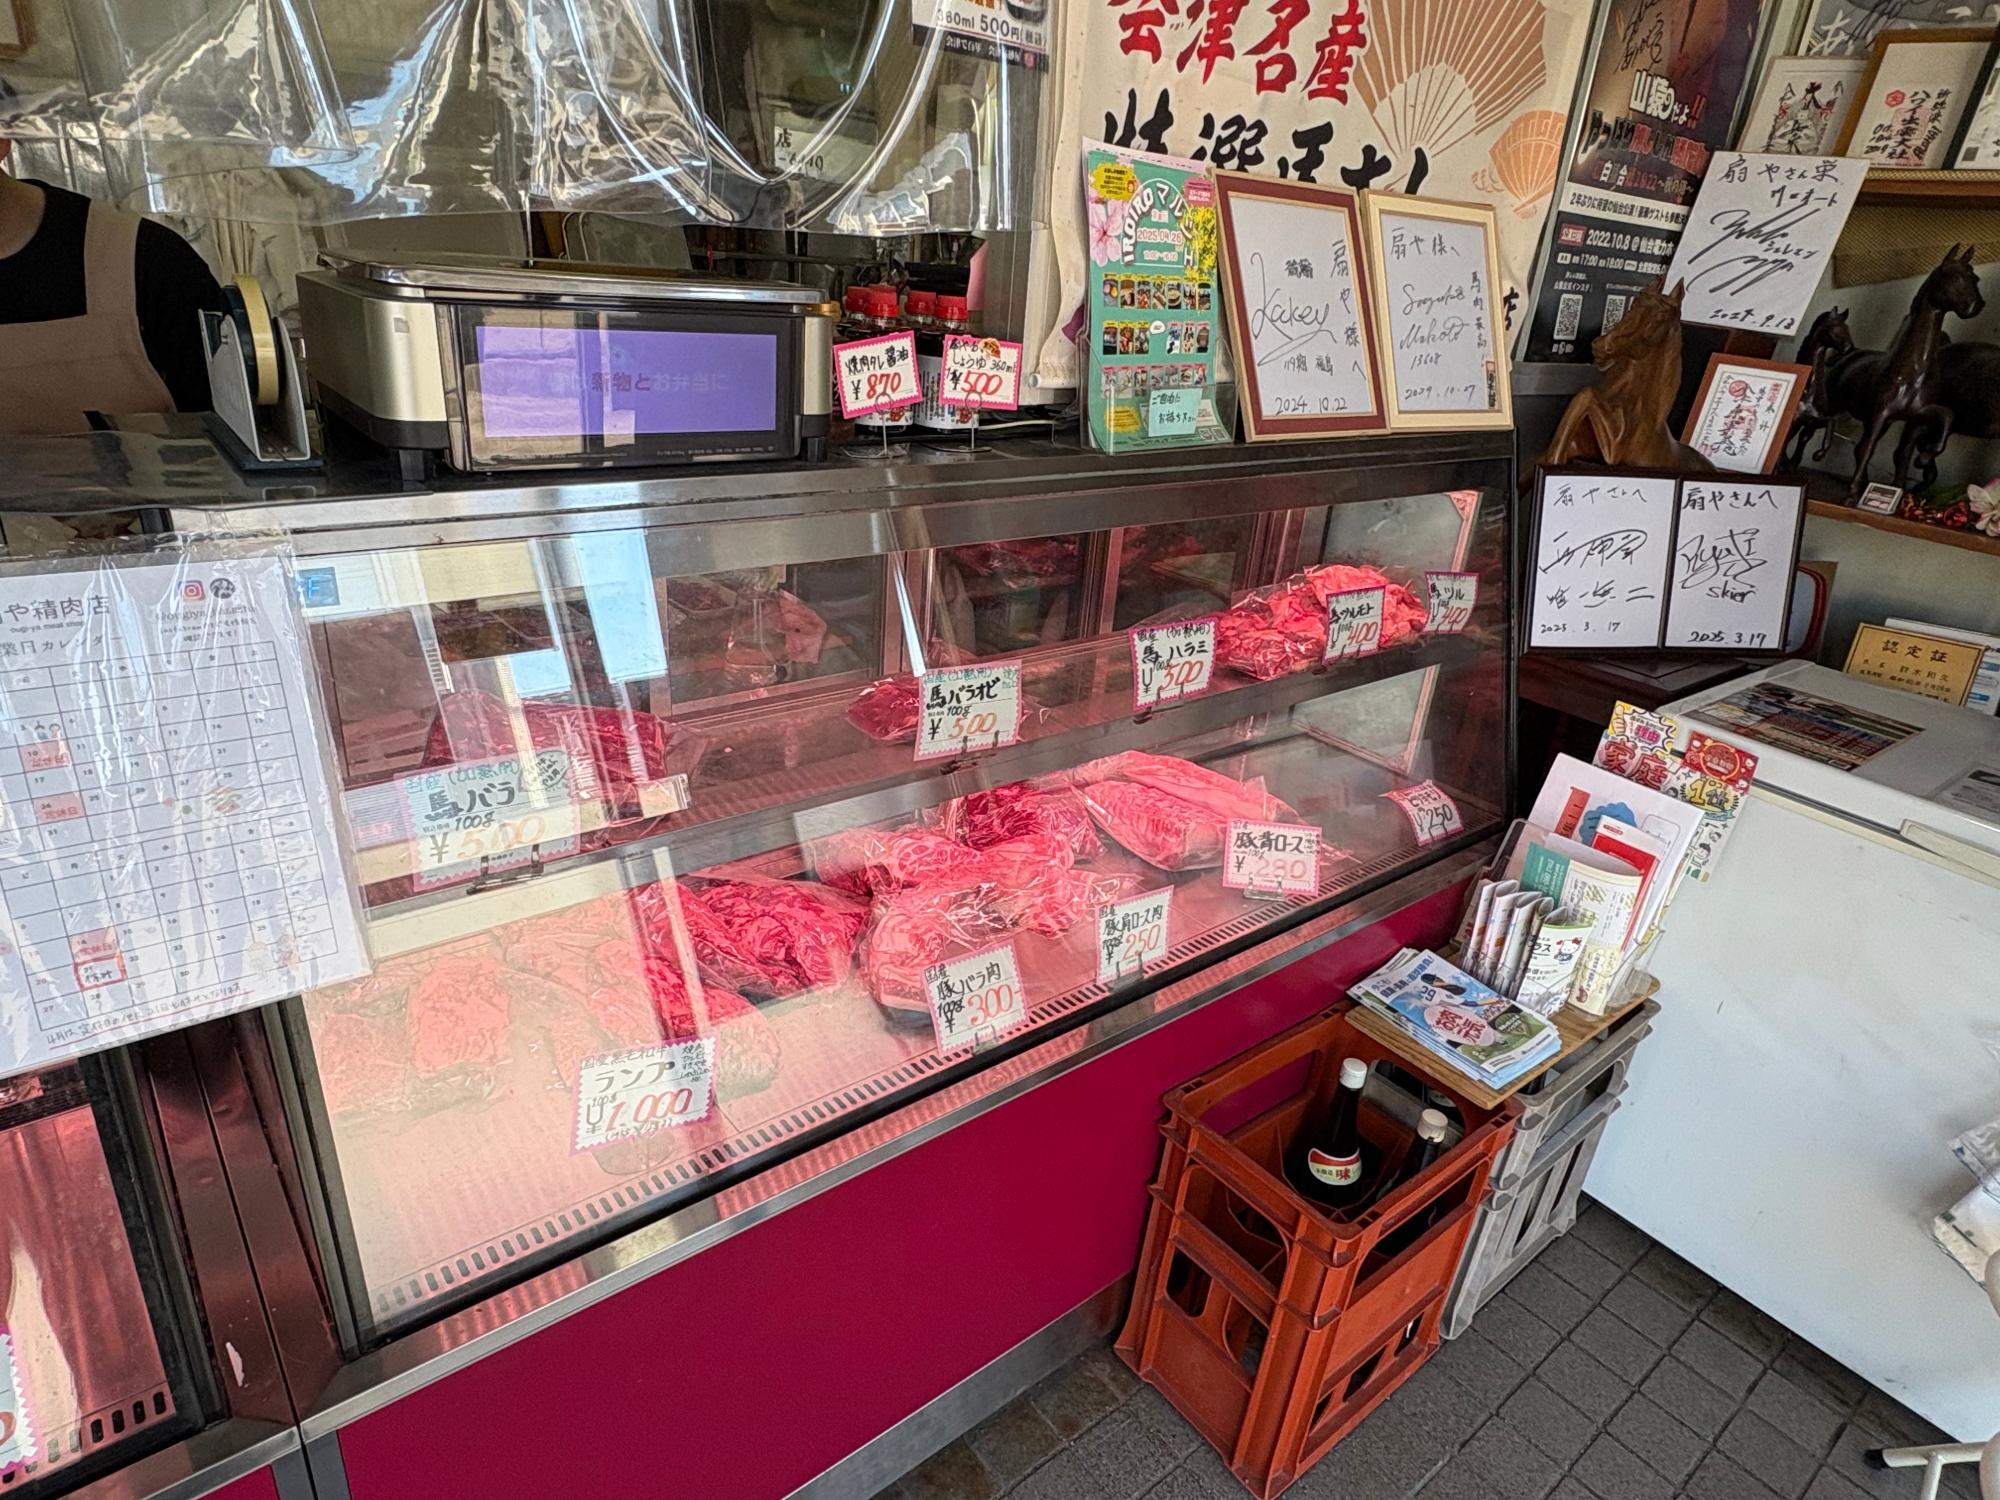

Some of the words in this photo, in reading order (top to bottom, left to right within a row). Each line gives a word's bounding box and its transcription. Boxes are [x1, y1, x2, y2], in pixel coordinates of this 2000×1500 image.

[1108, 0, 1367, 106] 会津名産
[953, 354, 987, 370] しょうゆ
[866, 372, 901, 399] 870
[960, 370, 1003, 396] 500
[1682, 487, 1778, 511] 扇やさんへ
[1347, 621, 1379, 646] 400
[1881, 639, 1948, 663] 認定証
[1160, 660, 1204, 690] 500
[928, 718, 942, 740] ¥
[948, 712, 998, 738] 500
[1602, 738, 1669, 791] 家庭
[424, 780, 516, 822] 馬バラ
[1426, 803, 1453, 828] 250
[455, 811, 496, 831] 100g
[429, 832, 450, 863] ¥
[456, 814, 545, 858] 500
[1233, 855, 1246, 873] ¥
[1256, 859, 1307, 880] 280
[1122, 924, 1161, 961] 250
[936, 962, 1002, 1000] 豚バラ肉
[967, 984, 1013, 1026] 300
[595, 1061, 675, 1093] ランプ
[585, 1103, 604, 1134] ¥
